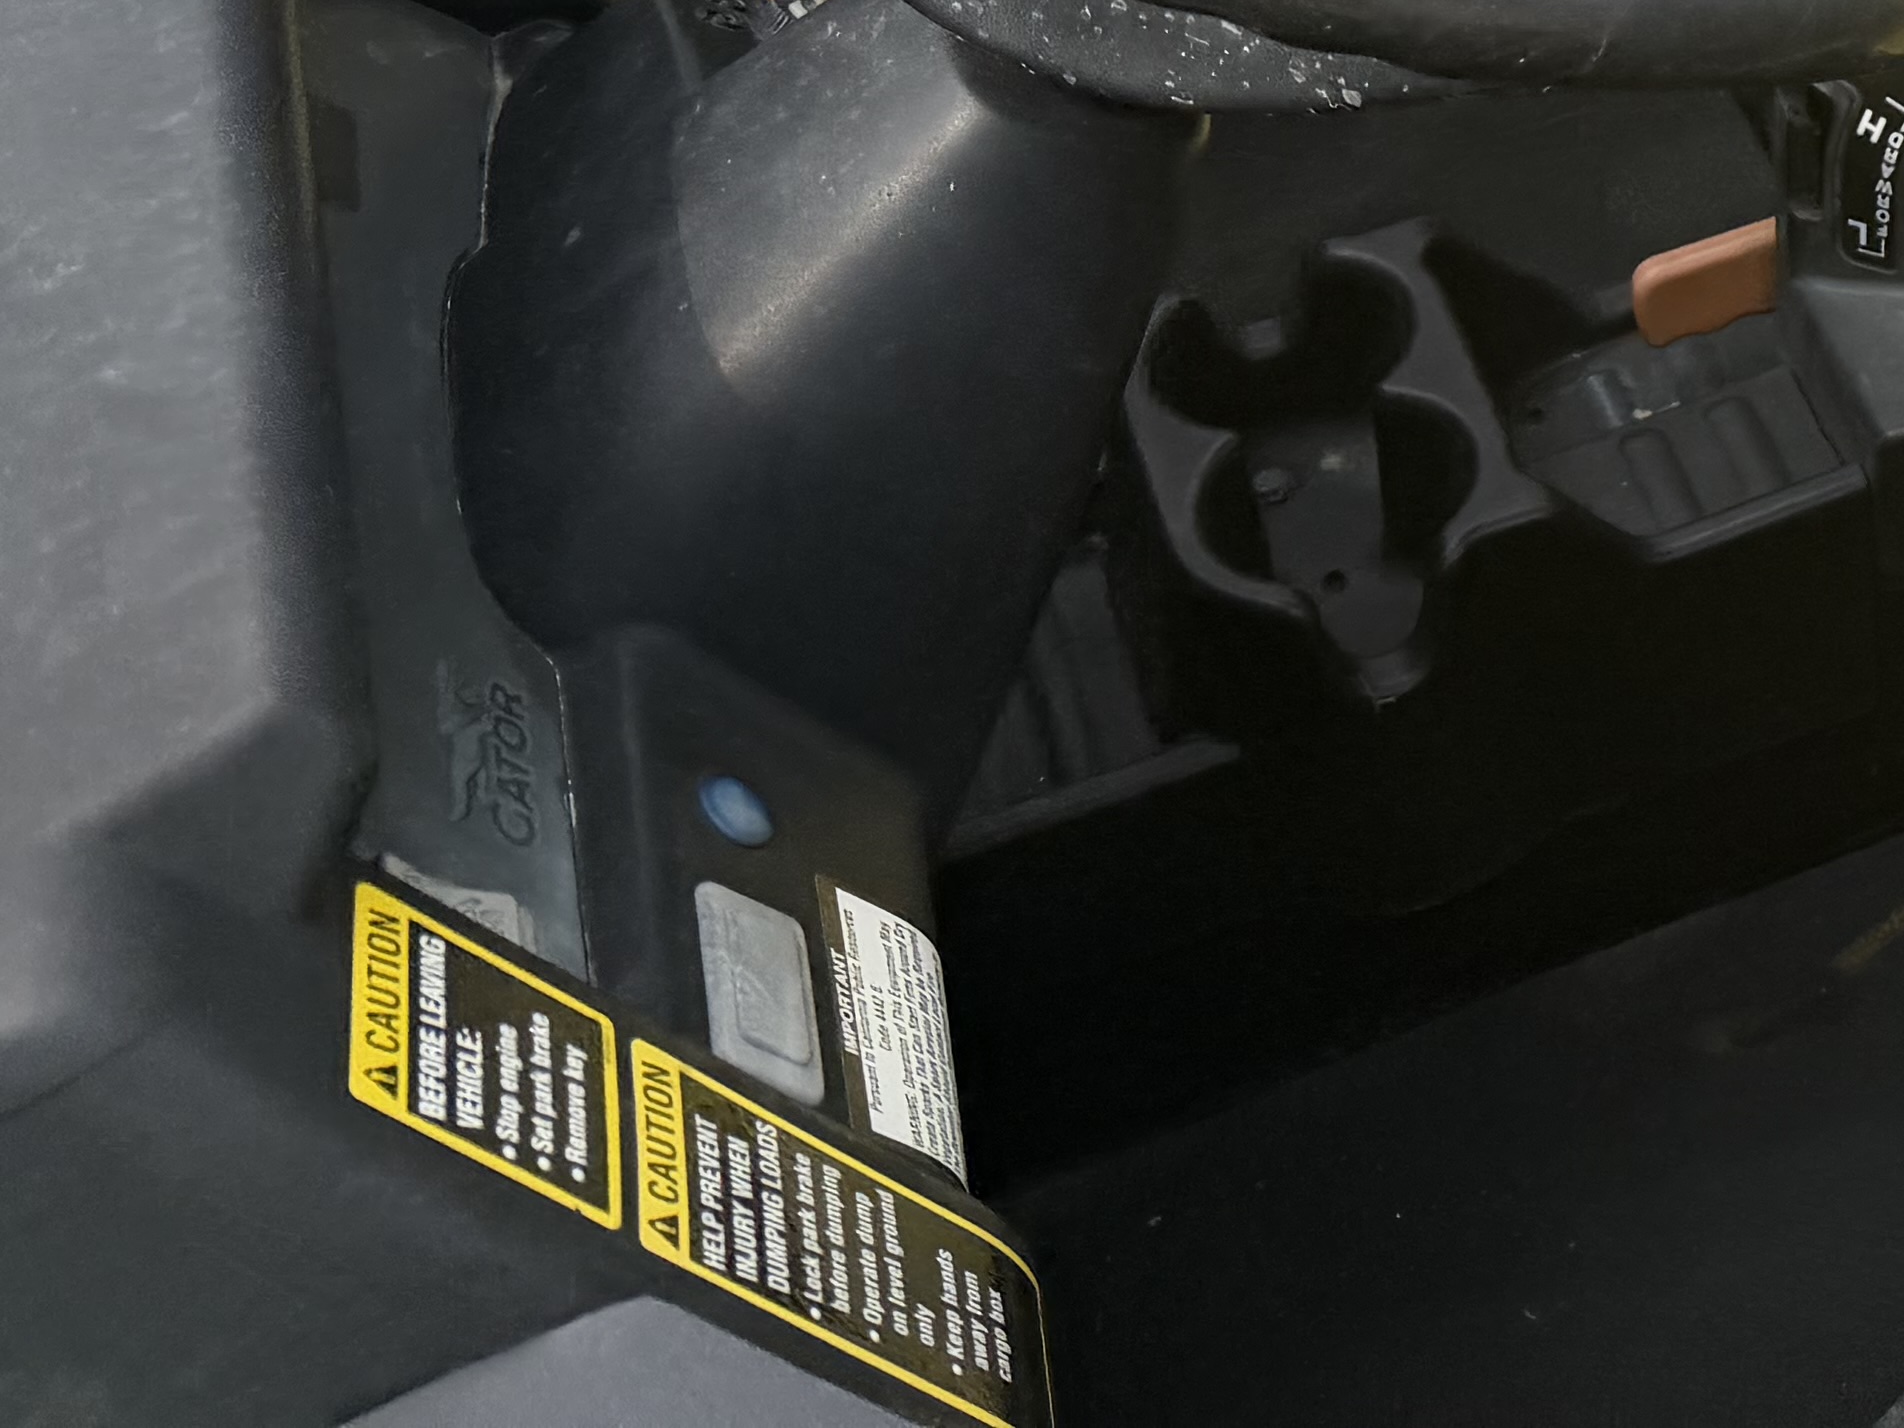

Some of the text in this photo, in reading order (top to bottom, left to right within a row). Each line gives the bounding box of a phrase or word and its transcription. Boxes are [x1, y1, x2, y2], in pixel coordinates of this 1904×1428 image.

[1856, 108, 1887, 144] H
[1875, 131, 1904, 238] FORWARD
[490, 681, 537, 847] GATOR
[365, 909, 400, 1053] CAUTION
[417, 933, 446, 1120] BEFORE LEAVING
[830, 947, 858, 1056] IMPORTANT
[877, 1023, 891, 1052] Code
[456, 1027, 484, 1129] VEHICLE:
[496, 1022, 524, 1144] Stop engine
[529, 1012, 557, 1154] Set park brake
[563, 1044, 588, 1165] Remove key
[641, 1061, 679, 1204] CAUTION
[695, 1113, 727, 1271] HELP PREVENT
[727, 1135, 758, 1283] INJURY WHEN
[755, 1120, 791, 1294] DUMPING LOADS
[794, 1152, 823, 1304] Lock park brake
[820, 1163, 852, 1313] before dumping
[854, 1191, 884, 1325] Operate dump
[878, 1189, 909, 1336] on level ground
[914, 1303, 937, 1346] only
[936, 1248, 966, 1359] Keep hands
[963, 1270, 991, 1370] away from
[988, 1286, 1013, 1382] cargo box
